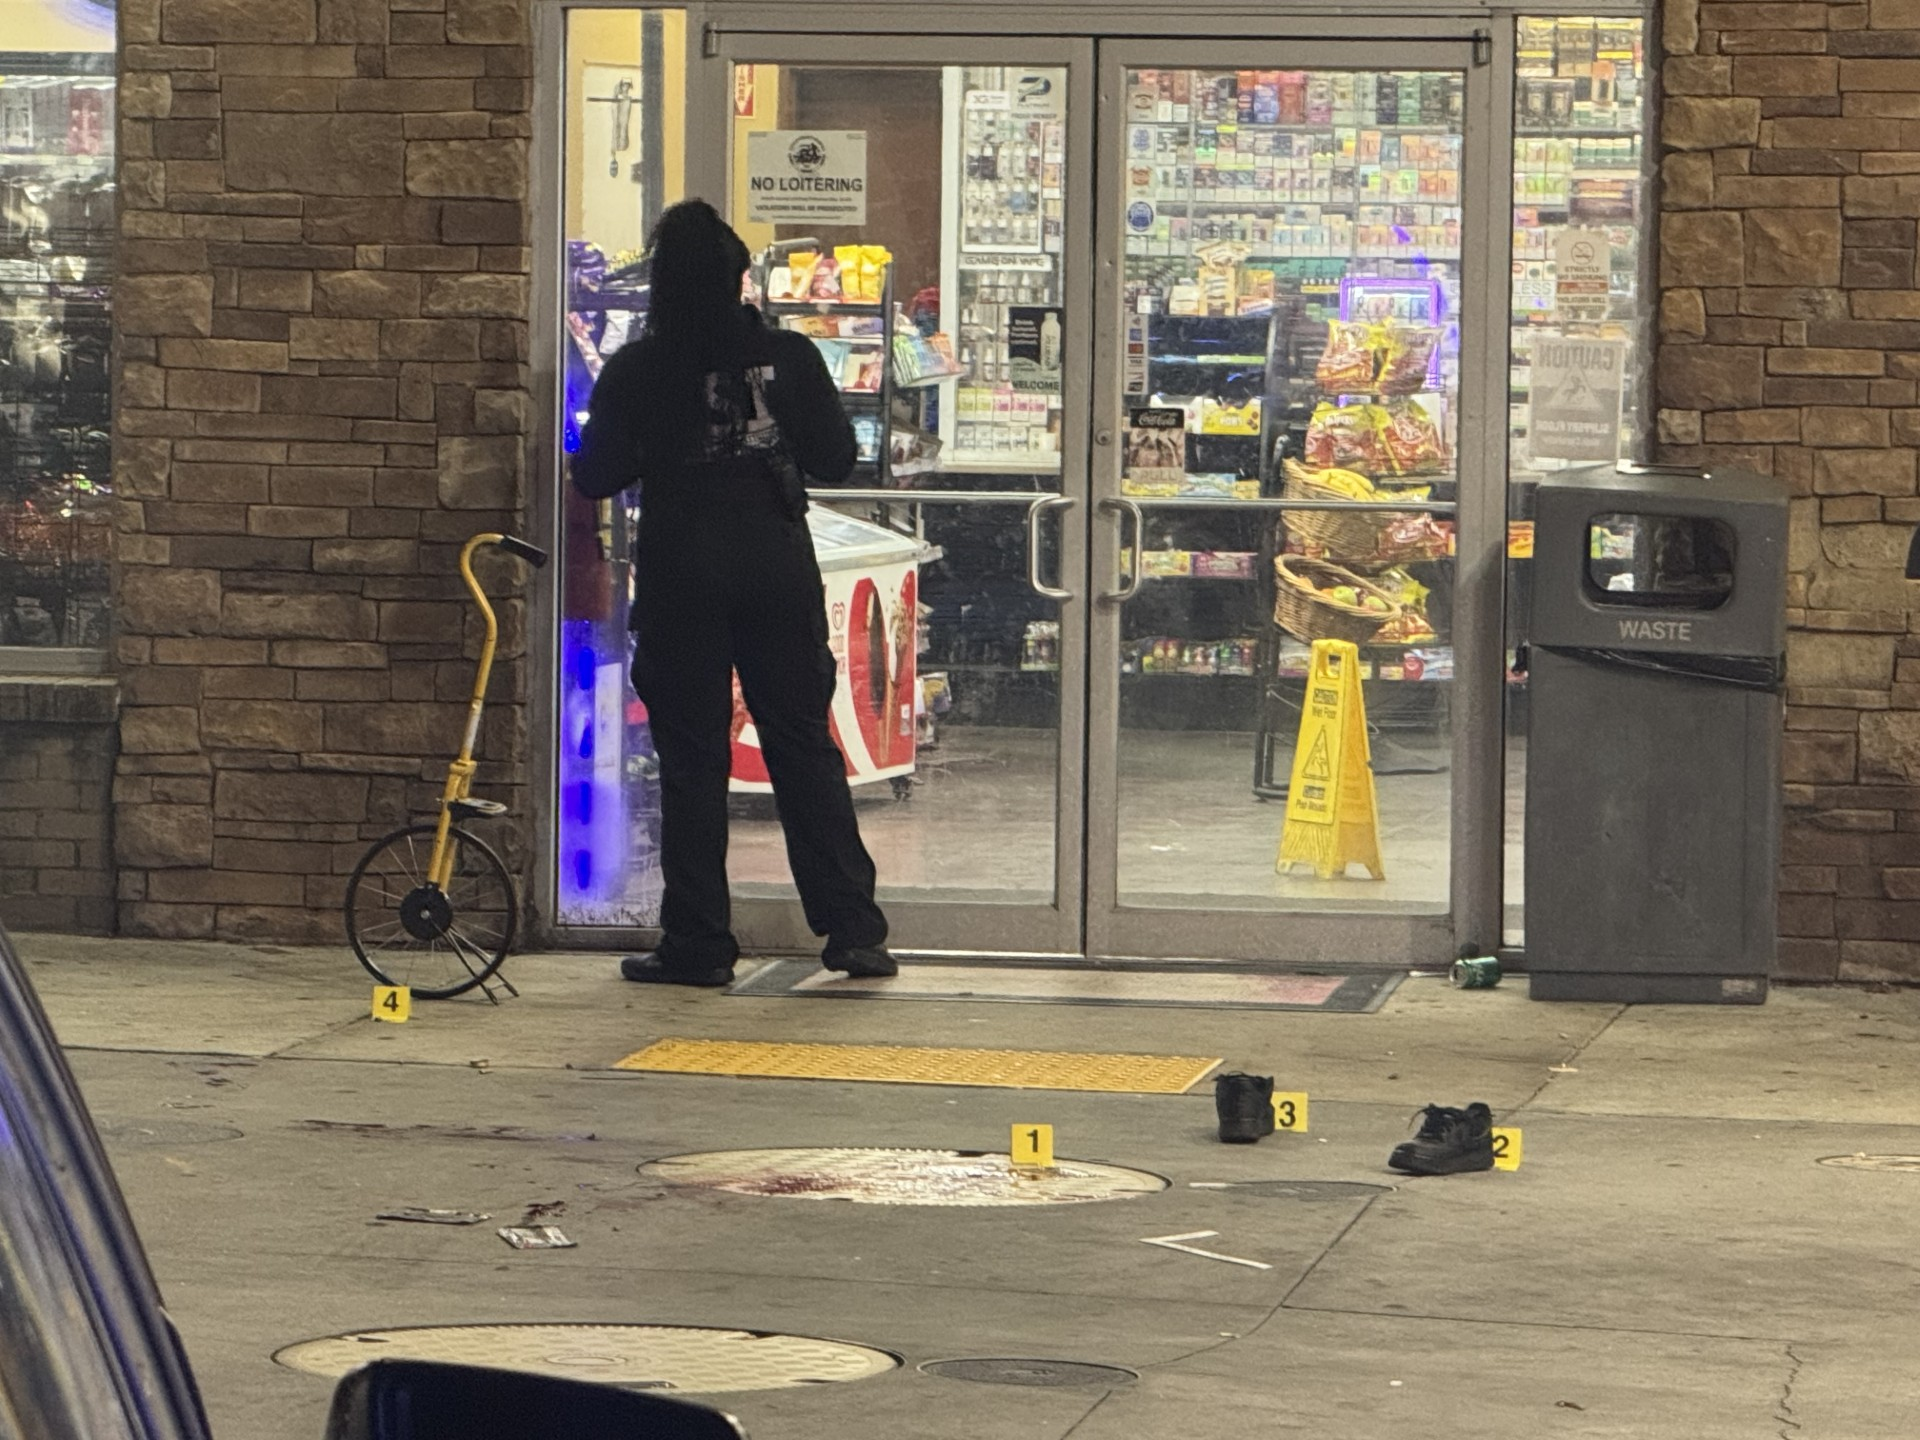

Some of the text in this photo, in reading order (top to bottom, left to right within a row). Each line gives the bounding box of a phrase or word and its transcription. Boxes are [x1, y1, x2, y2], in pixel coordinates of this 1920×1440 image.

[751, 177, 862, 191] NO LOITERING
[1013, 381, 1060, 390] WELCOME
[1619, 621, 1691, 640] WASTE
[383, 991, 399, 1012] 4
[1279, 1100, 1296, 1128] 3
[1027, 1129, 1039, 1153] 1
[1492, 1135, 1510, 1158] 2
